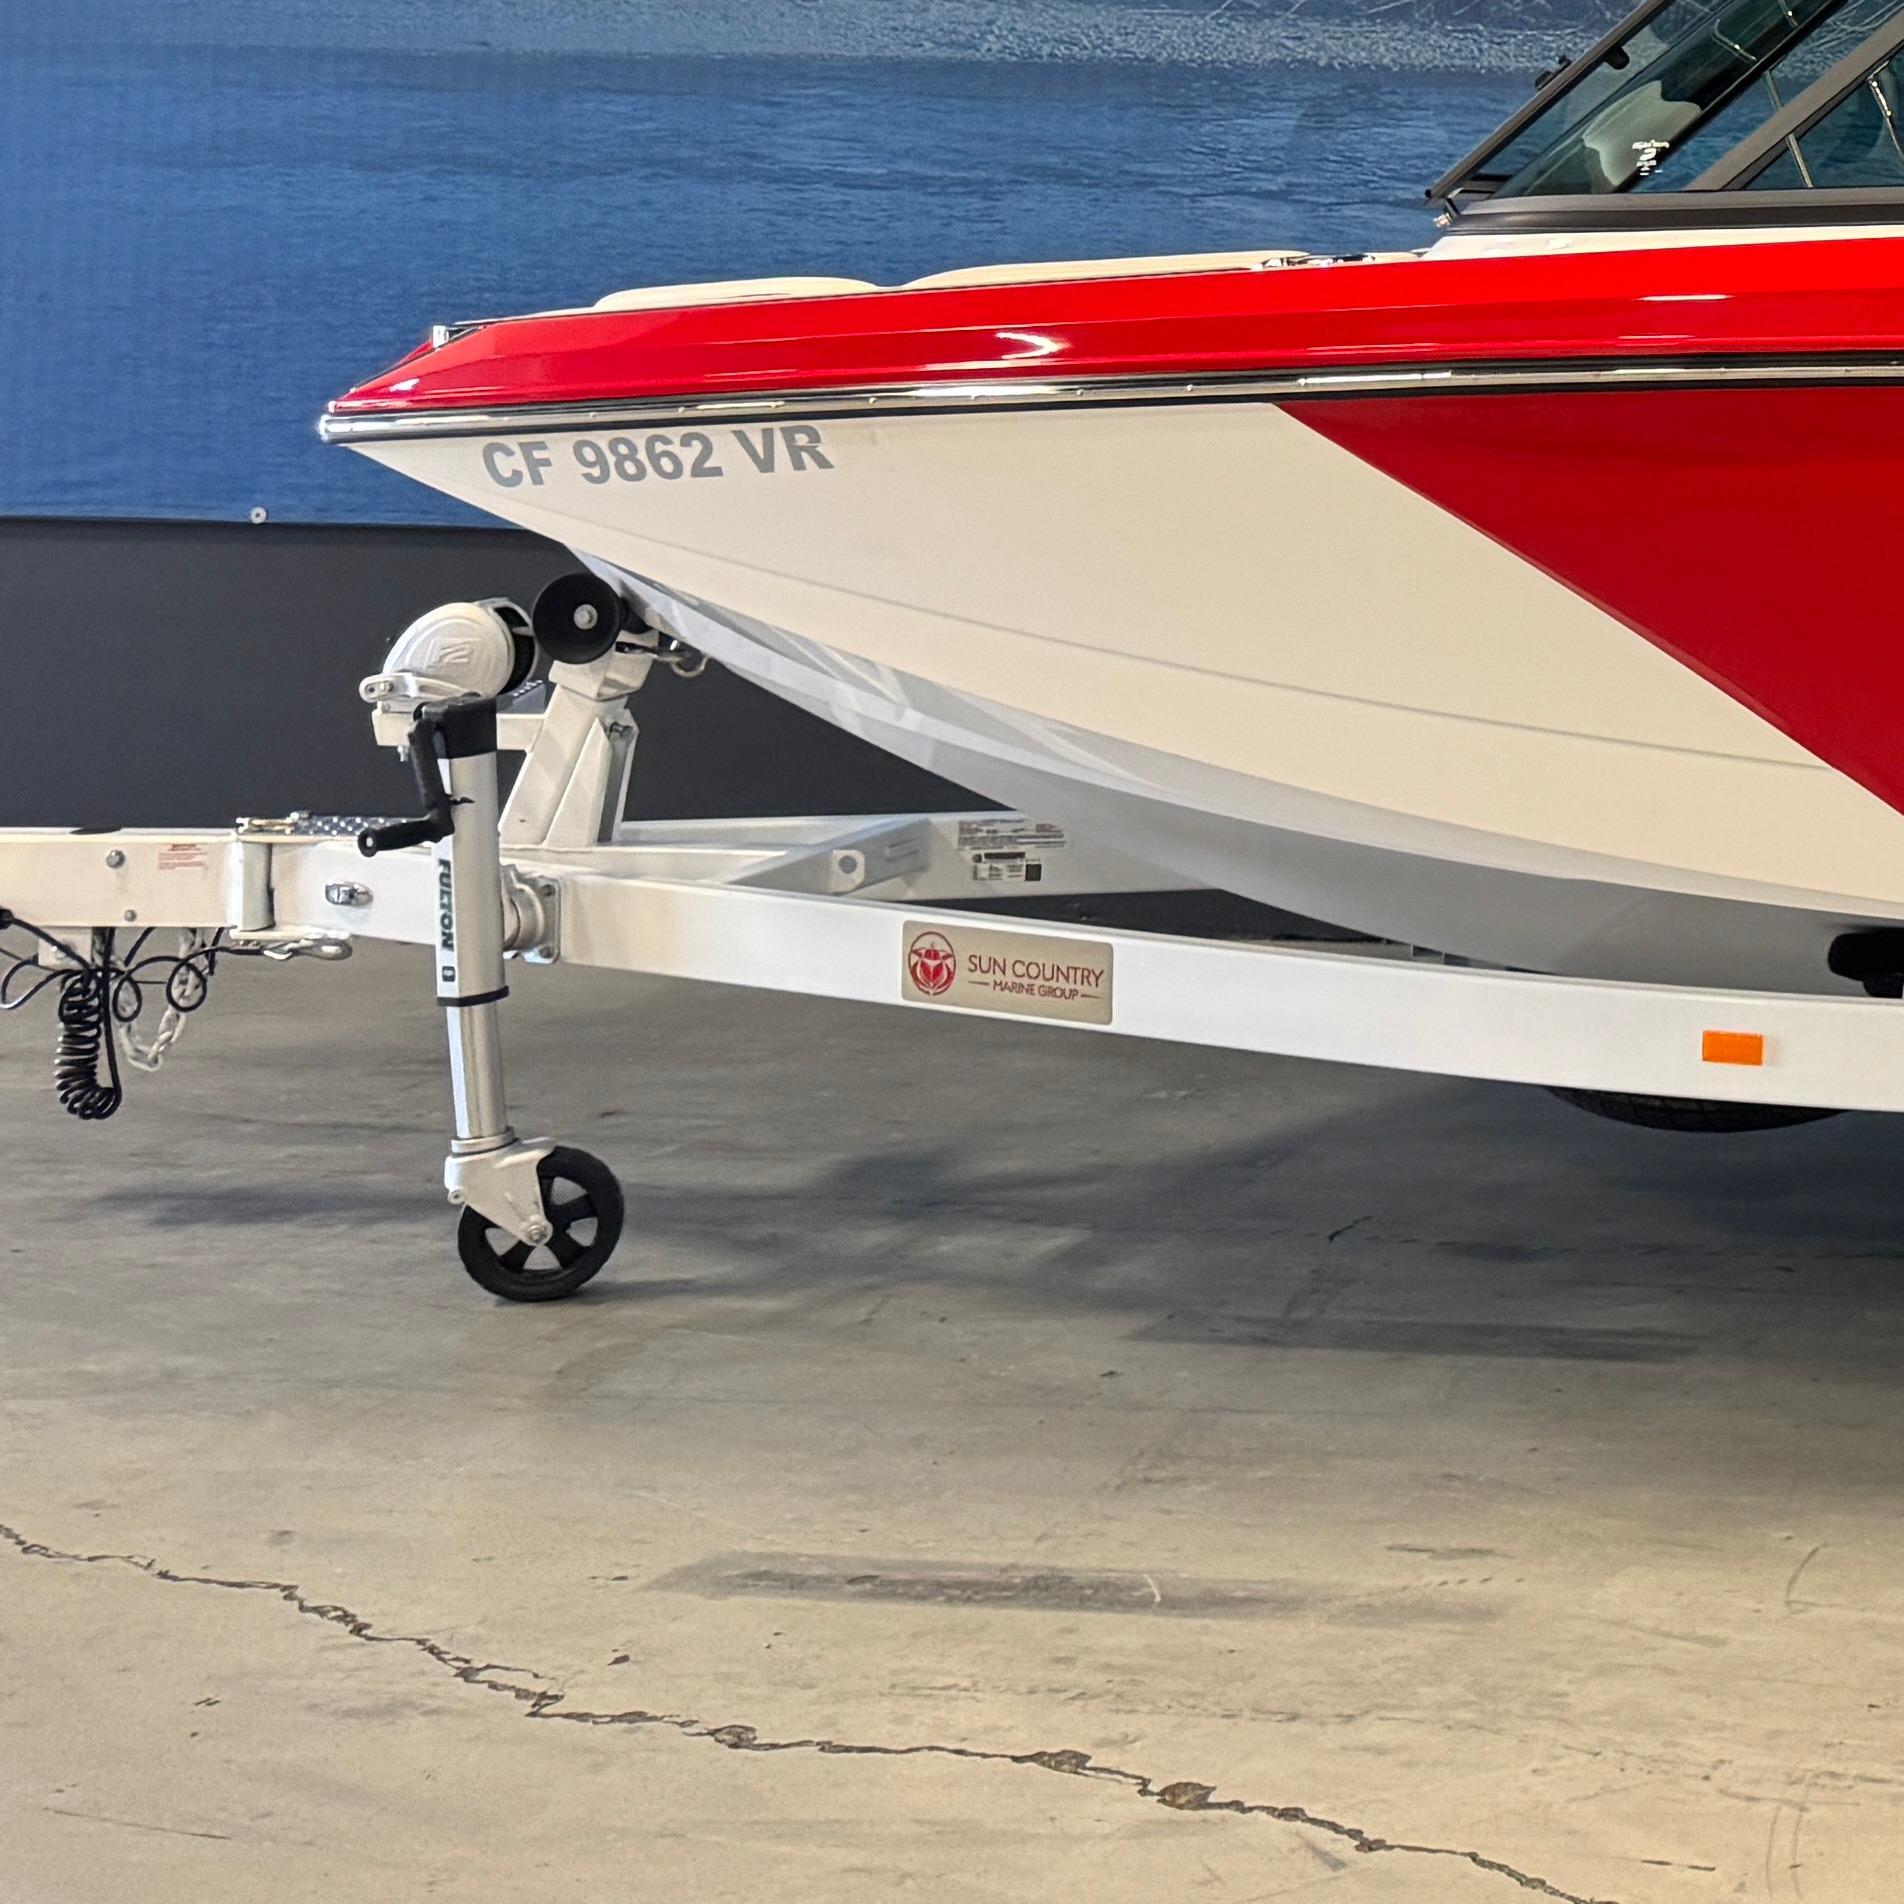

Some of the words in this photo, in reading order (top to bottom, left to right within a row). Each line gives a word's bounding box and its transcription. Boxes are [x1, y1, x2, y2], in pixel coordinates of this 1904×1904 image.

[482, 441, 553, 488] CF
[572, 431, 724, 485] 9862
[732, 424, 835, 474] VR
[437, 857, 455, 952] FULTON
[967, 954, 1008, 977] SUN
[1012, 959, 1105, 988] COUNTRY
[993, 979, 1036, 997] MARINE
[1037, 985, 1079, 1001] GROUP
